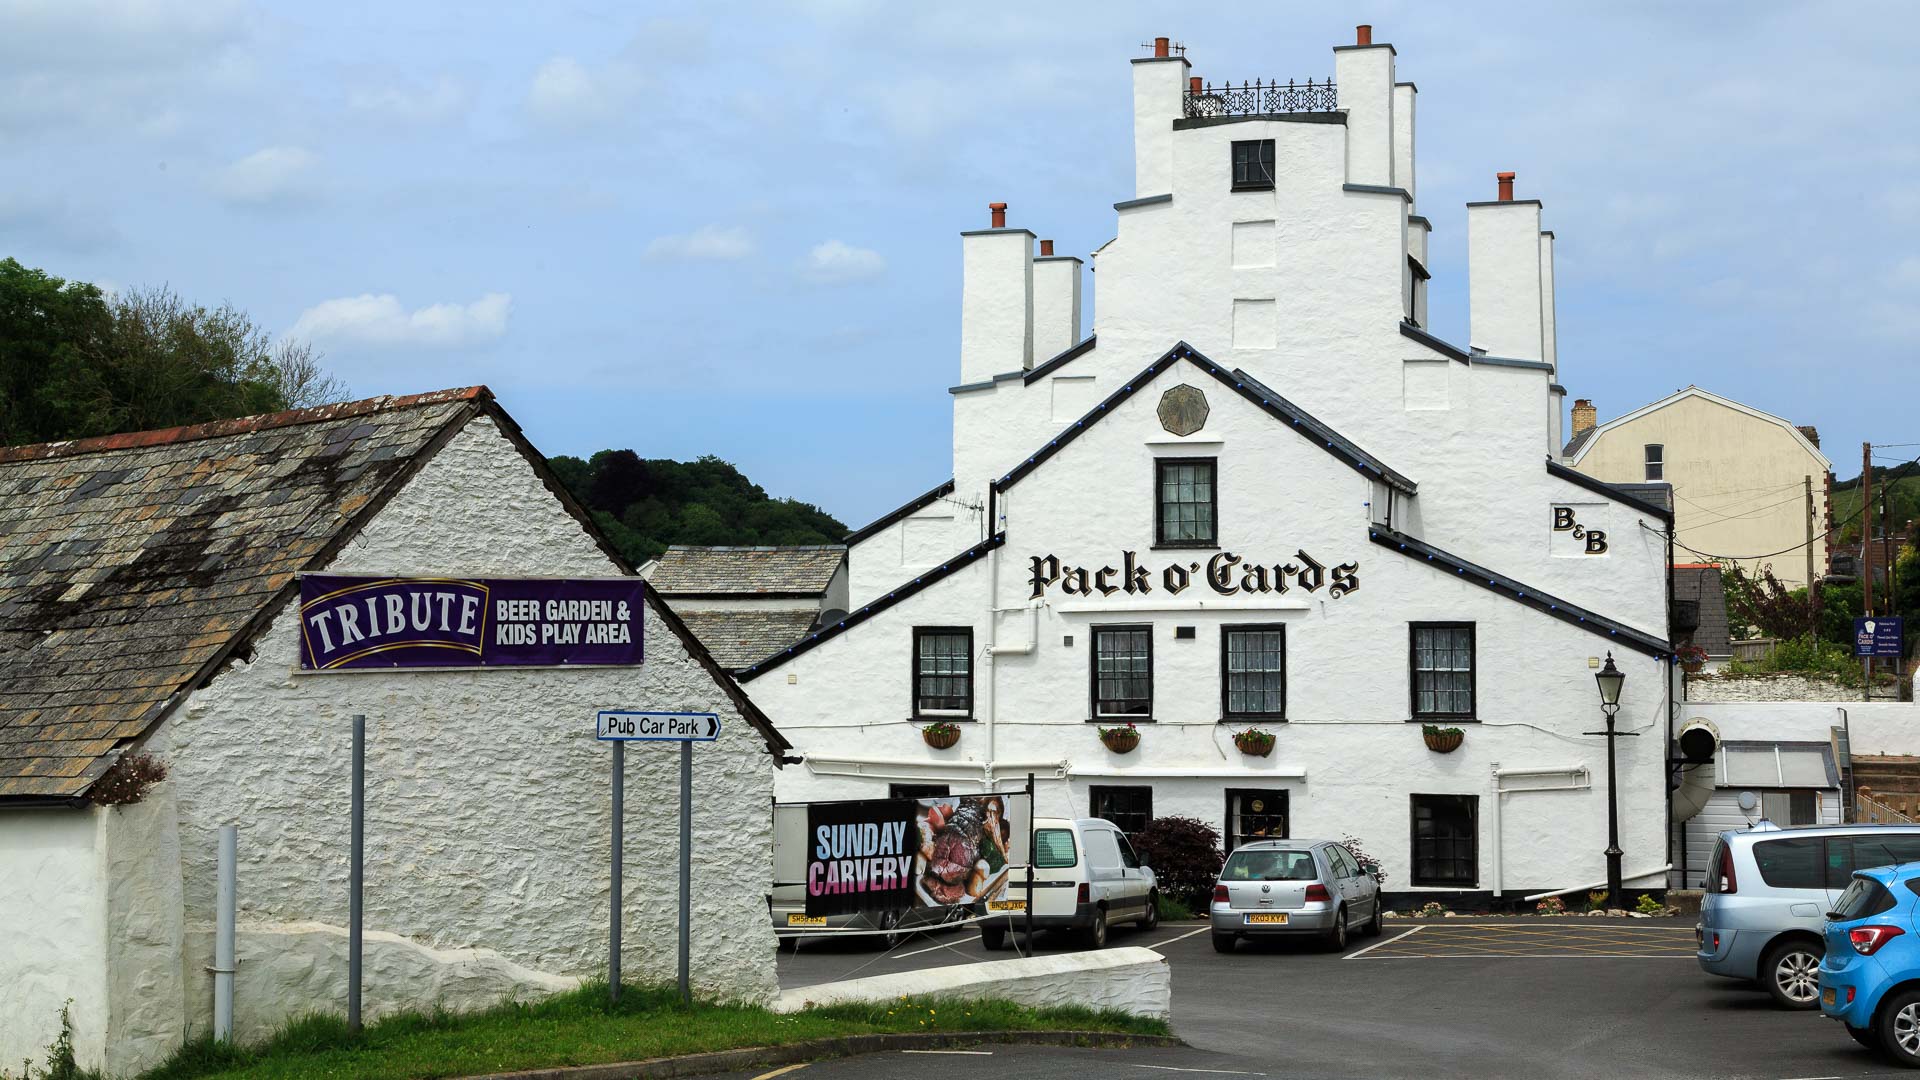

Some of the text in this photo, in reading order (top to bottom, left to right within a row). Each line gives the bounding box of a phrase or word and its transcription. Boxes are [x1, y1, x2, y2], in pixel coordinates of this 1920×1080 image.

[1028, 549, 1360, 600] Pack o' Cards
[310, 592, 479, 654] TRIBUTE
[496, 600, 631, 621] BEER GARDEN &
[496, 623, 631, 645] KIDS PLAY AREA
[608, 717, 699, 735] Pub Car Park
[816, 821, 907, 859] SUNDAY
[809, 855, 912, 897] CARVERY
